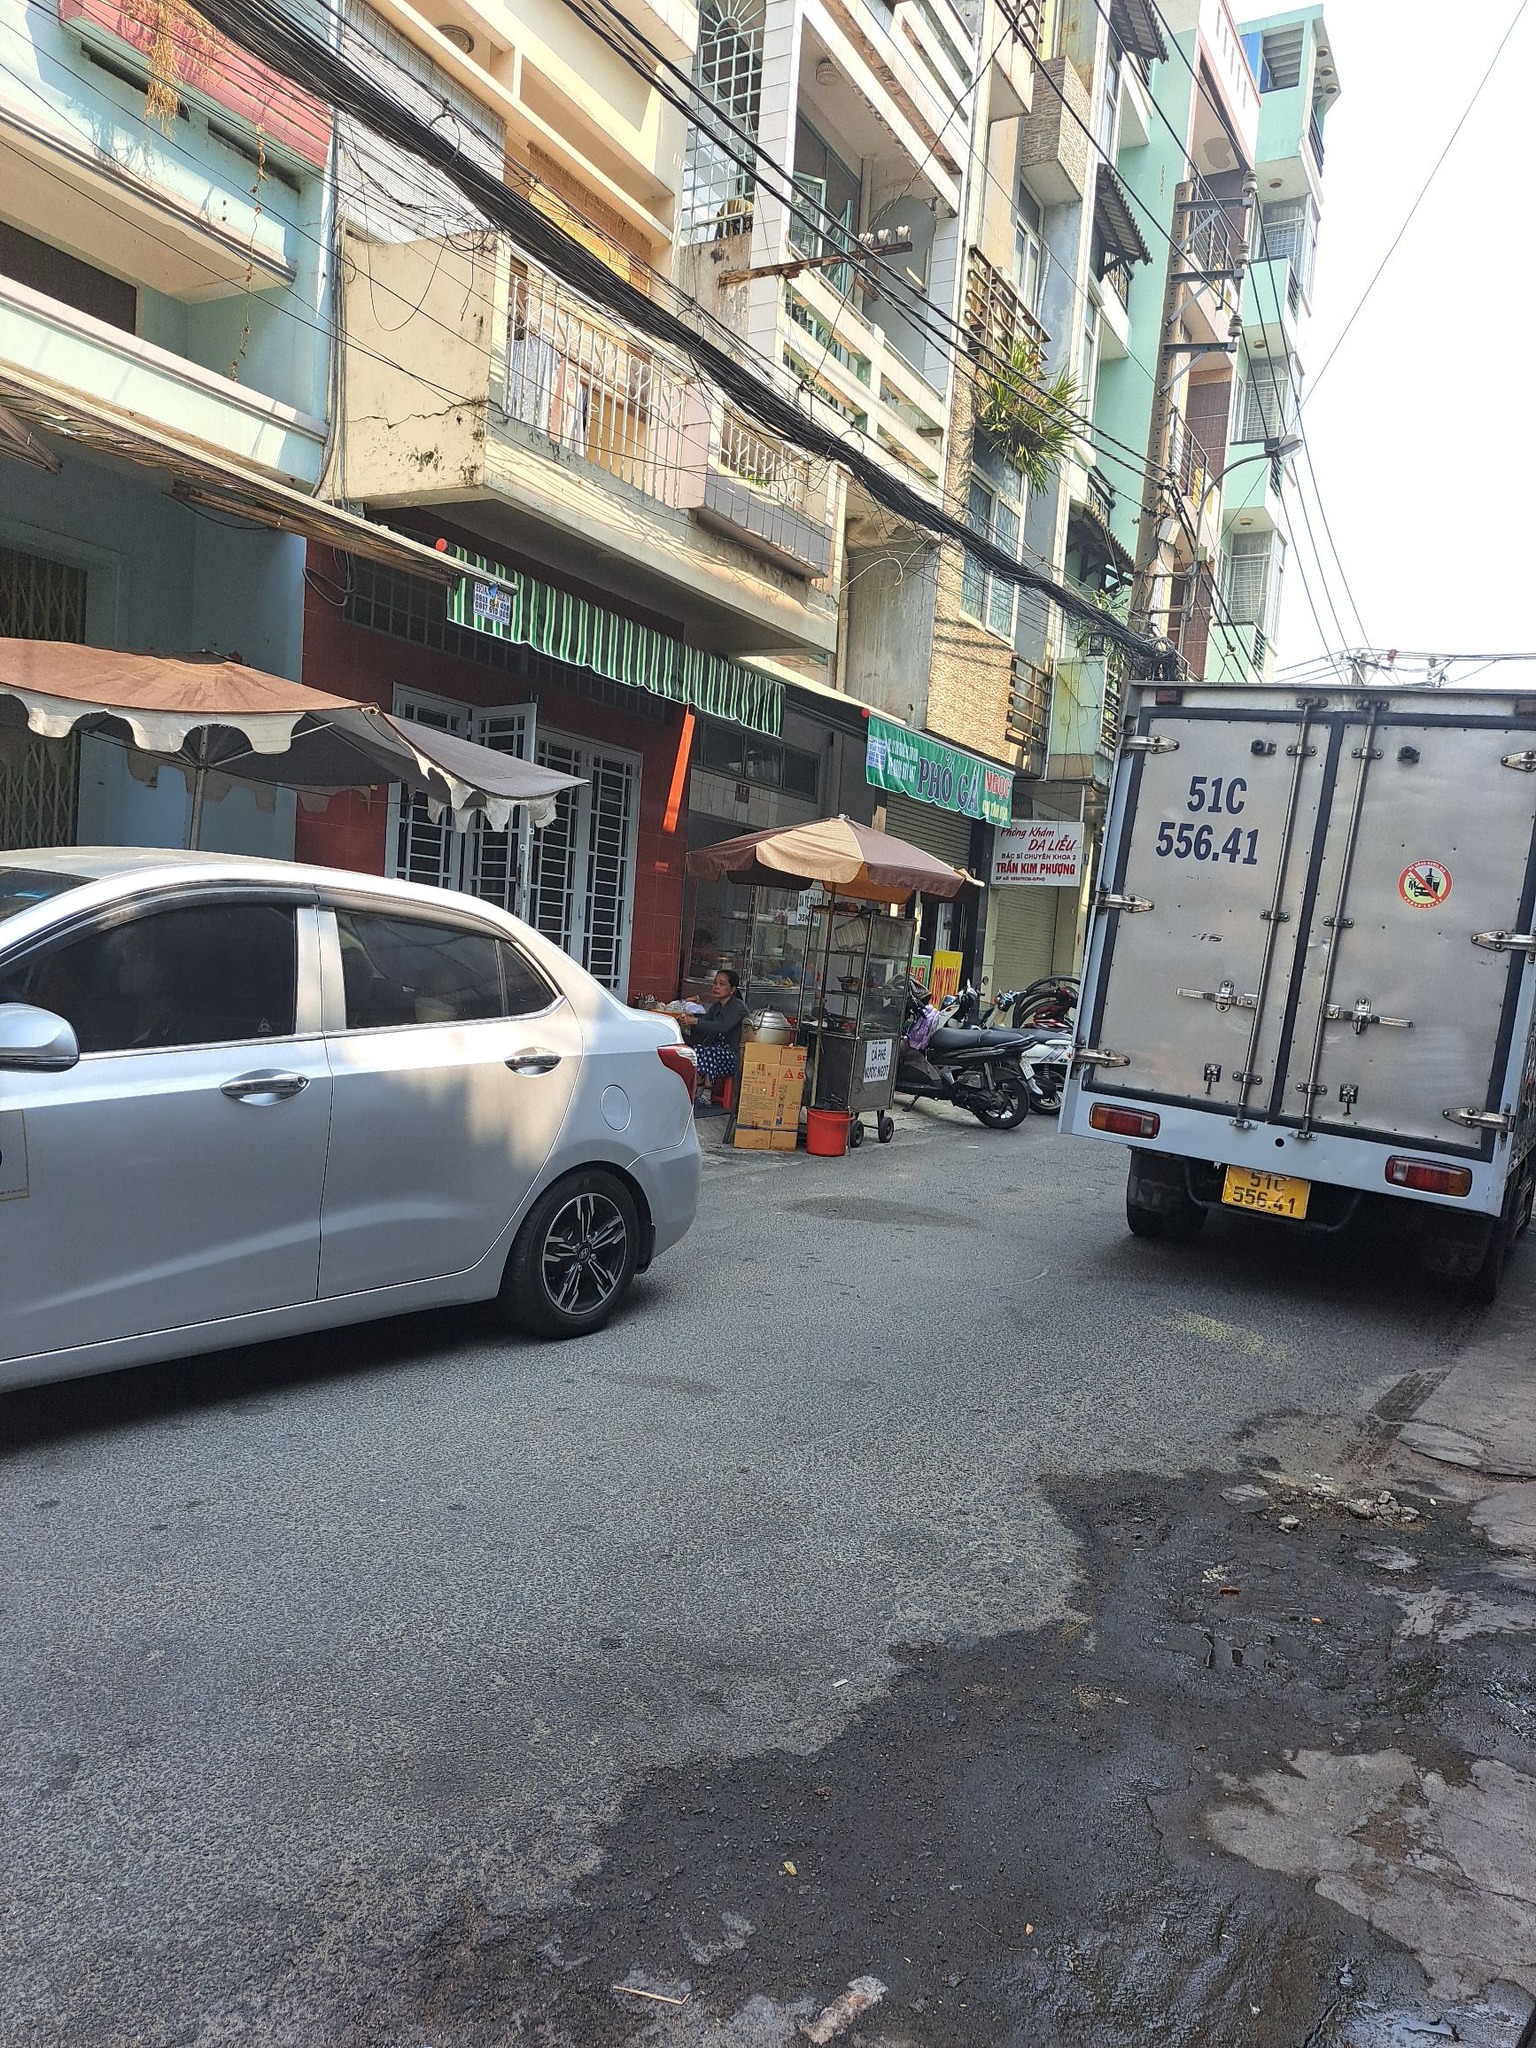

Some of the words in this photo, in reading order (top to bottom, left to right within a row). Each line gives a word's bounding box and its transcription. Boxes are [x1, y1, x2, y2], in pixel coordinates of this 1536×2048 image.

[916, 752, 954, 803] PHỞ
[957, 763, 979, 813] GÀ
[985, 769, 1011, 800] NGỌC
[1187, 775, 1247, 815] 51C
[1028, 838, 1047, 852] DA
[1047, 834, 1077, 852] LIỄU
[1029, 826, 1055, 838] Khám
[1155, 821, 1259, 865] 556.41
[1020, 863, 1038, 875] KIM
[1040, 862, 1076, 877] PHƯỢNG
[1250, 1170, 1287, 1192] 51C
[1232, 1185, 1296, 1214] 556.41
